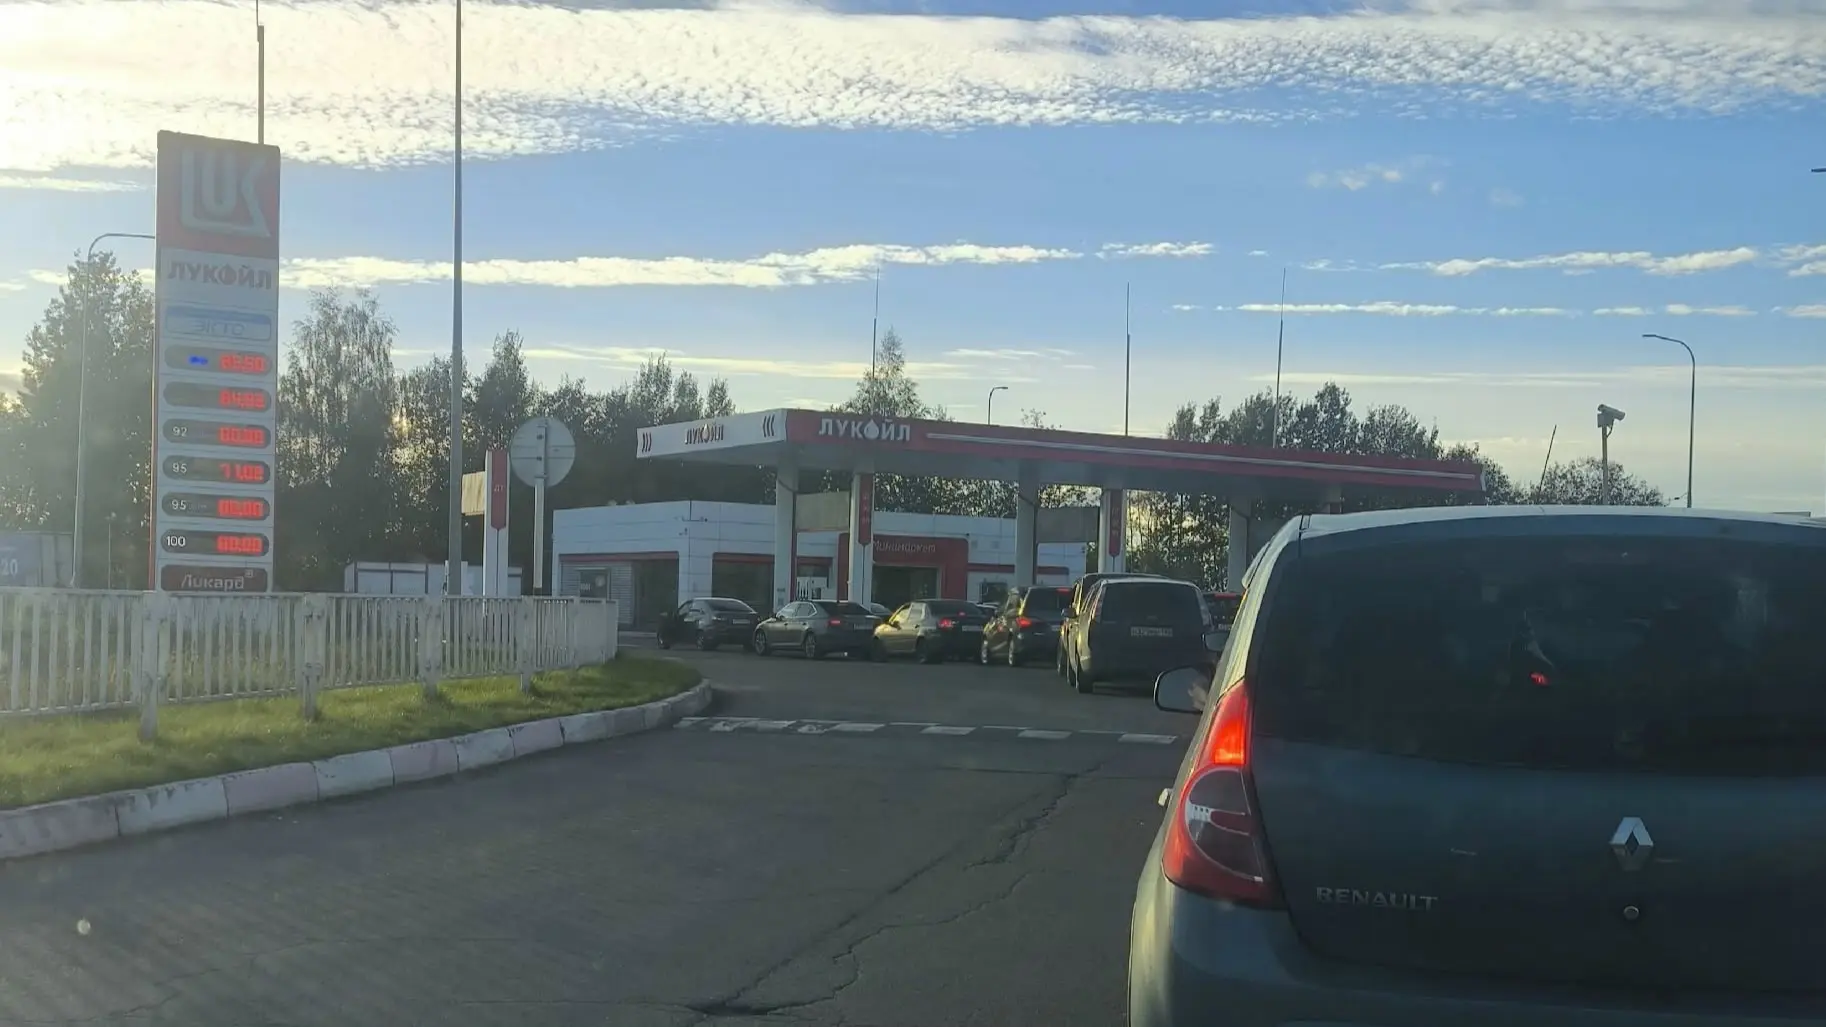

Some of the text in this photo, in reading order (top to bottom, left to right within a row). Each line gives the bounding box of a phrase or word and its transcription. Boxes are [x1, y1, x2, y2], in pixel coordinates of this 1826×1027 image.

[167, 261, 271, 290] ЛУКОЙЛ
[172, 426, 188, 437] 92
[685, 423, 725, 446] ЛУКОЙЛ
[819, 418, 911, 442] ЛУКОЙЛ
[172, 463, 188, 474] 95
[171, 499, 187, 510] 95
[166, 536, 186, 547] 100
[1315, 886, 1438, 911] RENAULT
